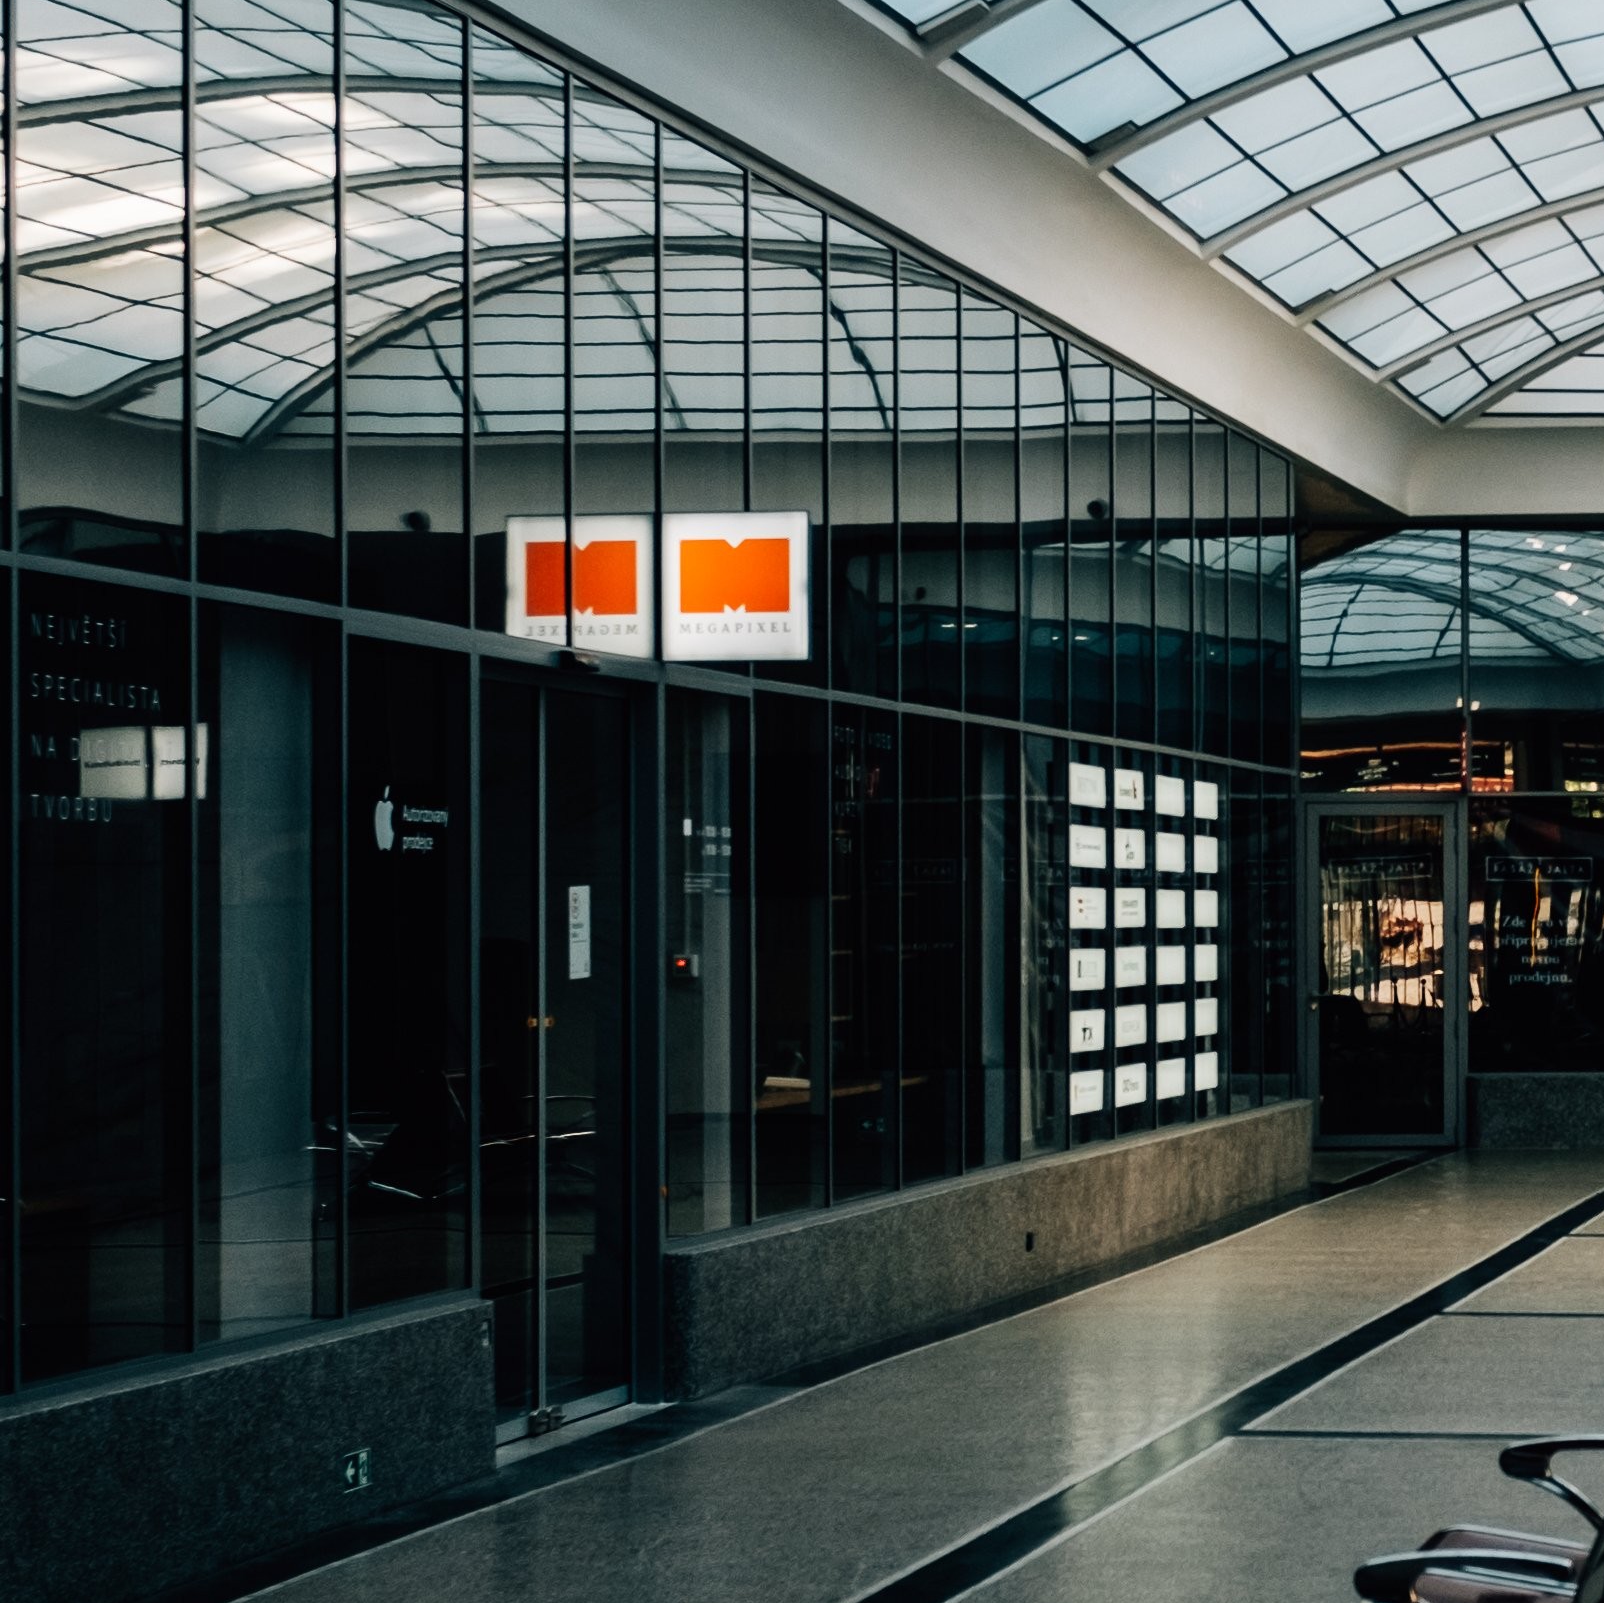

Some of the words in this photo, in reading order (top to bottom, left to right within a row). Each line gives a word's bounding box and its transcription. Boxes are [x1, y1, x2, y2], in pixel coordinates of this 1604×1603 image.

[679, 621, 791, 634] MEGAPIXEL
[31, 672, 161, 711] SPECIALISTA
[31, 734, 57, 758] NA
[30, 794, 112, 823] TVORBU
